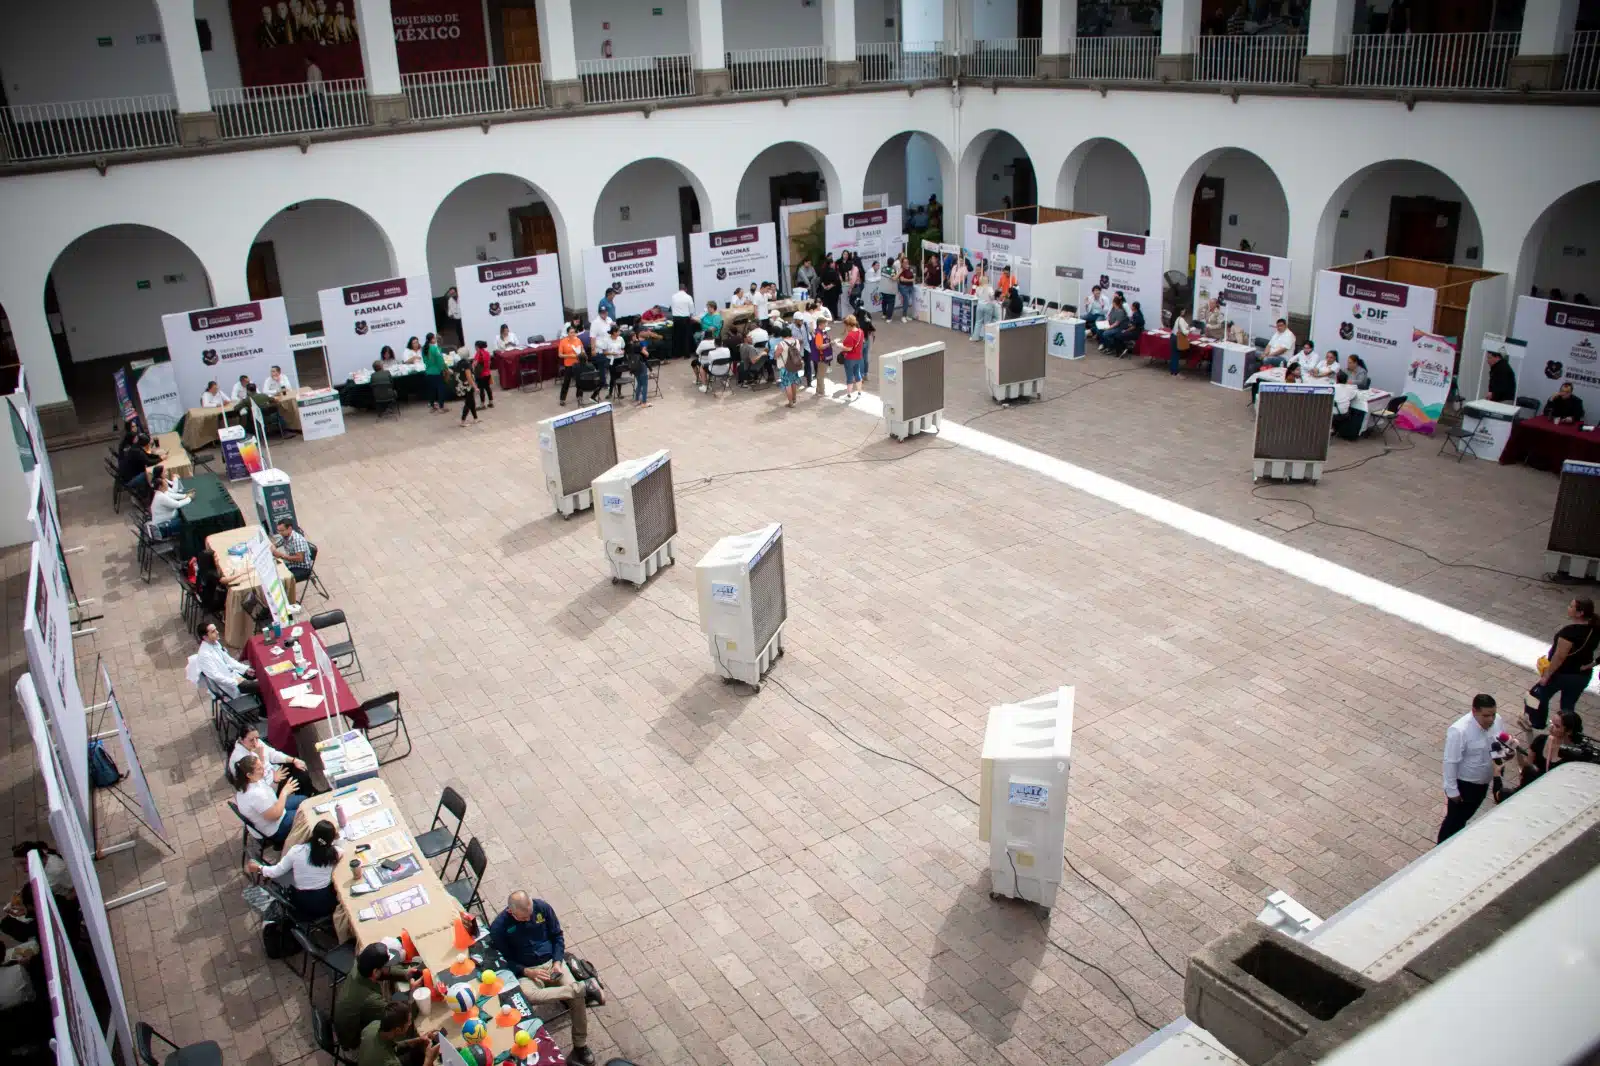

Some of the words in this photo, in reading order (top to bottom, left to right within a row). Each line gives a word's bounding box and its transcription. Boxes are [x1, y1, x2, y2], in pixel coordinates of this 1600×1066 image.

[393, 15, 442, 25] OBIERNO
[444, 13, 459, 23] DE
[395, 25, 460, 41] MÉXICO
[862, 229, 882, 237] SALUD
[721, 247, 750, 256] VACUNAS
[609, 262, 644, 272] SERVICIOS
[1114, 257, 1137, 267] SALUD
[611, 267, 654, 278] ENFERMERÍA
[728, 268, 756, 276] BIENESTAR
[1221, 272, 1251, 285] MÓDULO
[1251, 278, 1262, 286] DE
[491, 280, 530, 291] CONSULTA
[625, 282, 655, 290] BIENESTAR
[1111, 282, 1140, 293] BIENESTAR
[1227, 282, 1254, 293] DENGUE
[497, 287, 526, 297] MÉDICA
[354, 301, 403, 316] FARMACIA
[503, 301, 536, 311] BIENESTAR
[1366, 307, 1388, 319] DIF
[370, 319, 405, 330] BIENESTAR
[206, 327, 254, 341] IMMUJERES
[1356, 332, 1398, 347] BIENESTAR
[289, 339, 323, 348] IMMUJERES
[221, 347, 264, 360] BIENESTAR
[143, 391, 177, 404] IMMUJERES
[303, 406, 340, 417] IMMUJERES
